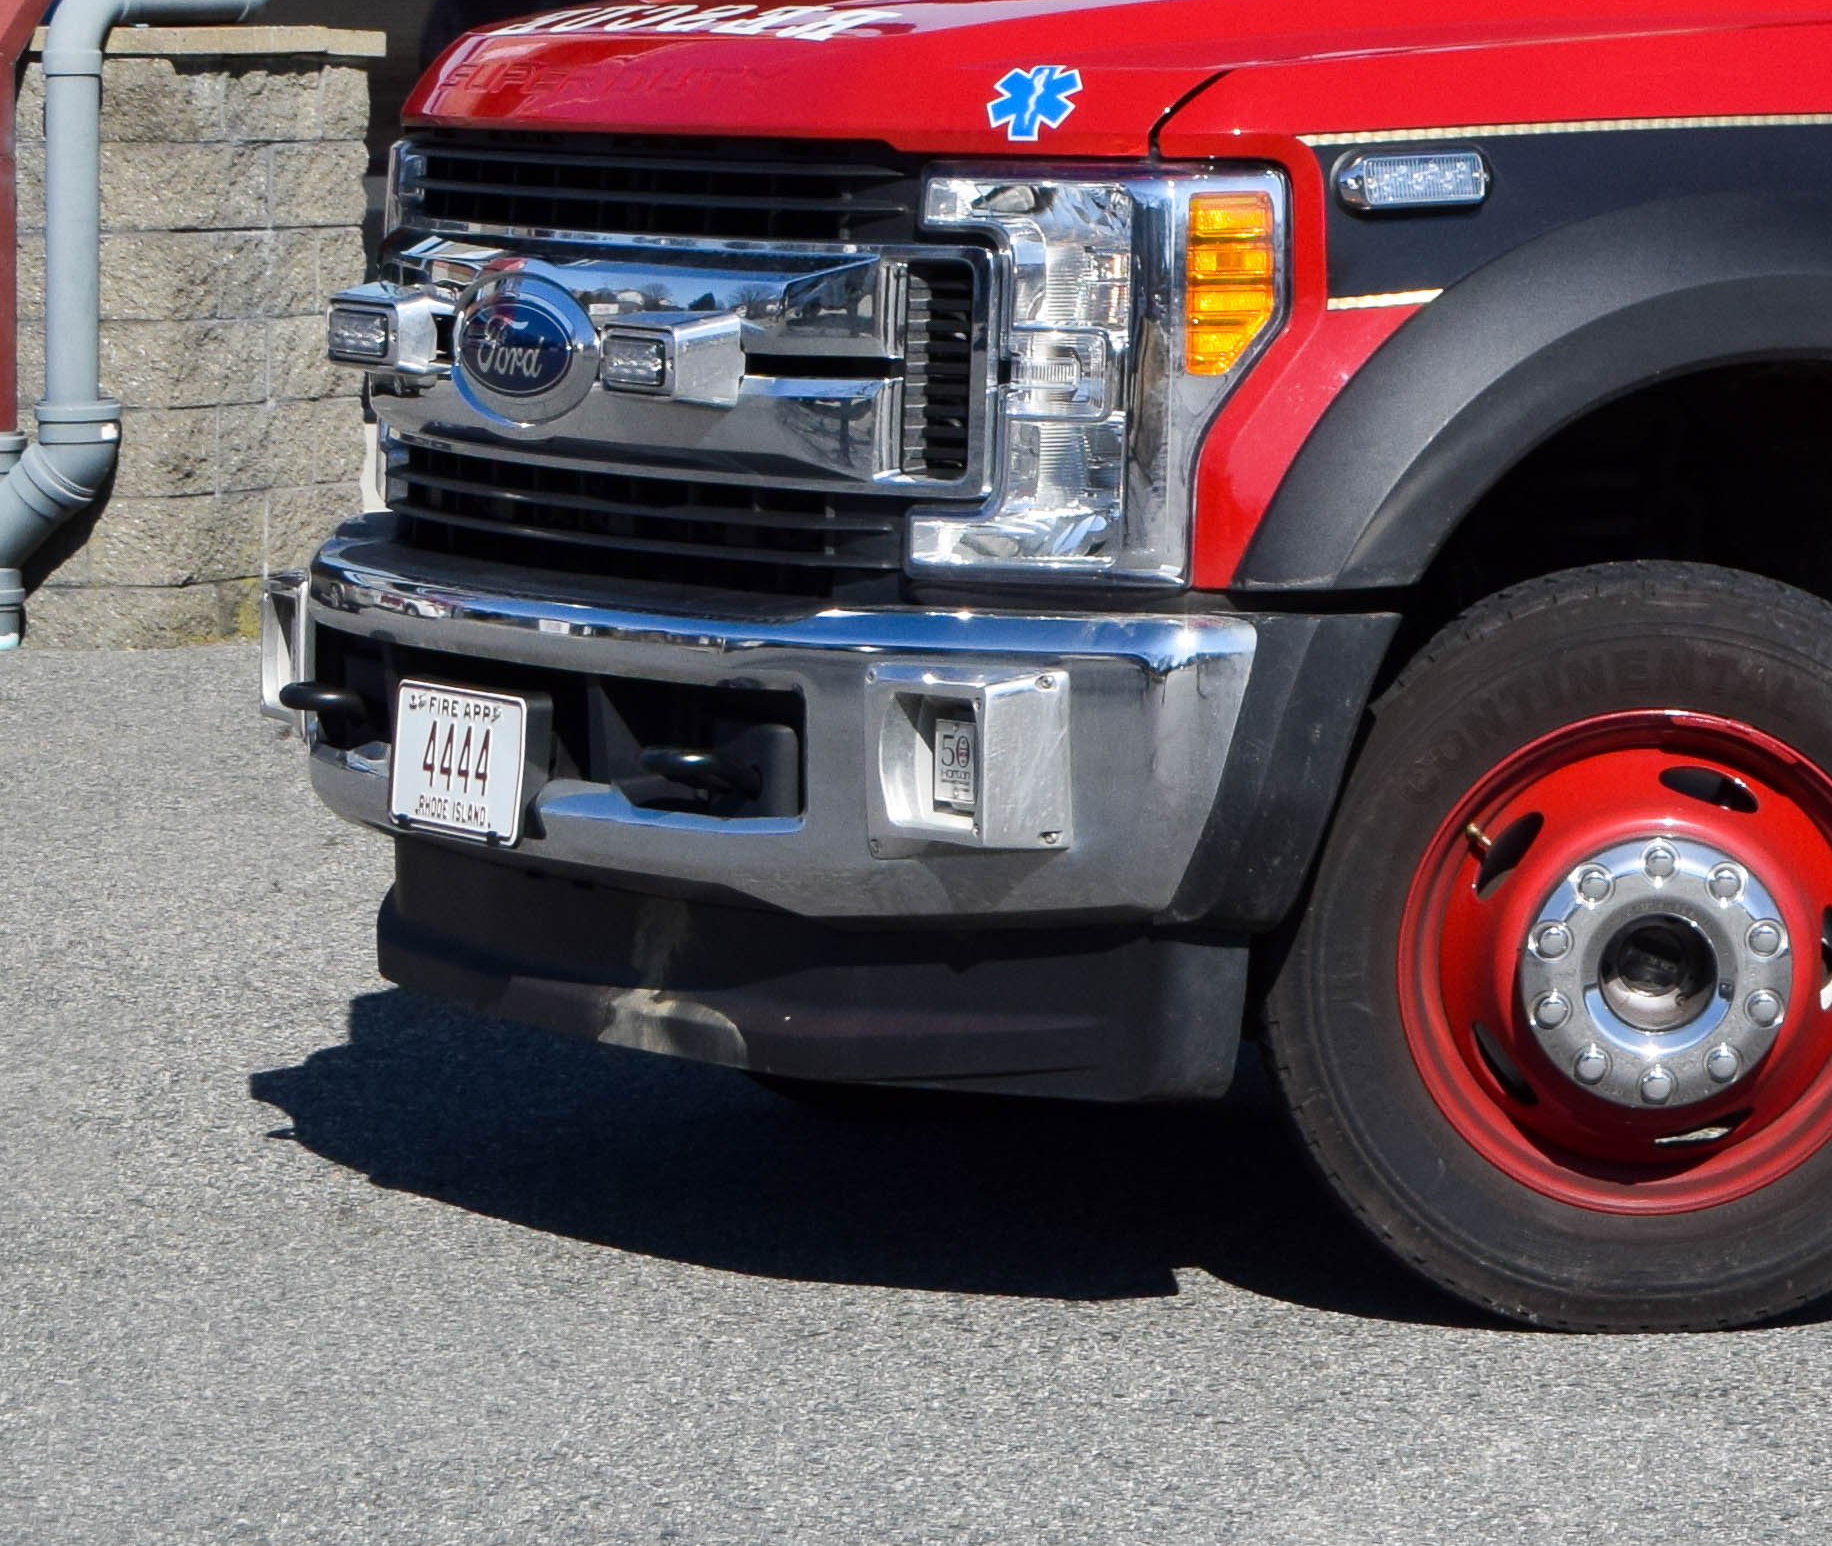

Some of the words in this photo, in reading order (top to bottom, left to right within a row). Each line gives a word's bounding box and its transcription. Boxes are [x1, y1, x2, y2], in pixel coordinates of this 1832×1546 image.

[441, 59, 595, 94] SUPER
[477, 314, 544, 378] Ford
[429, 696, 459, 718] FIRE
[1400, 648, 1808, 806] CONTINENTAL
[423, 720, 491, 796] 4444
[418, 795, 448, 820] RHODE
[452, 801, 487, 827] ISLAND
